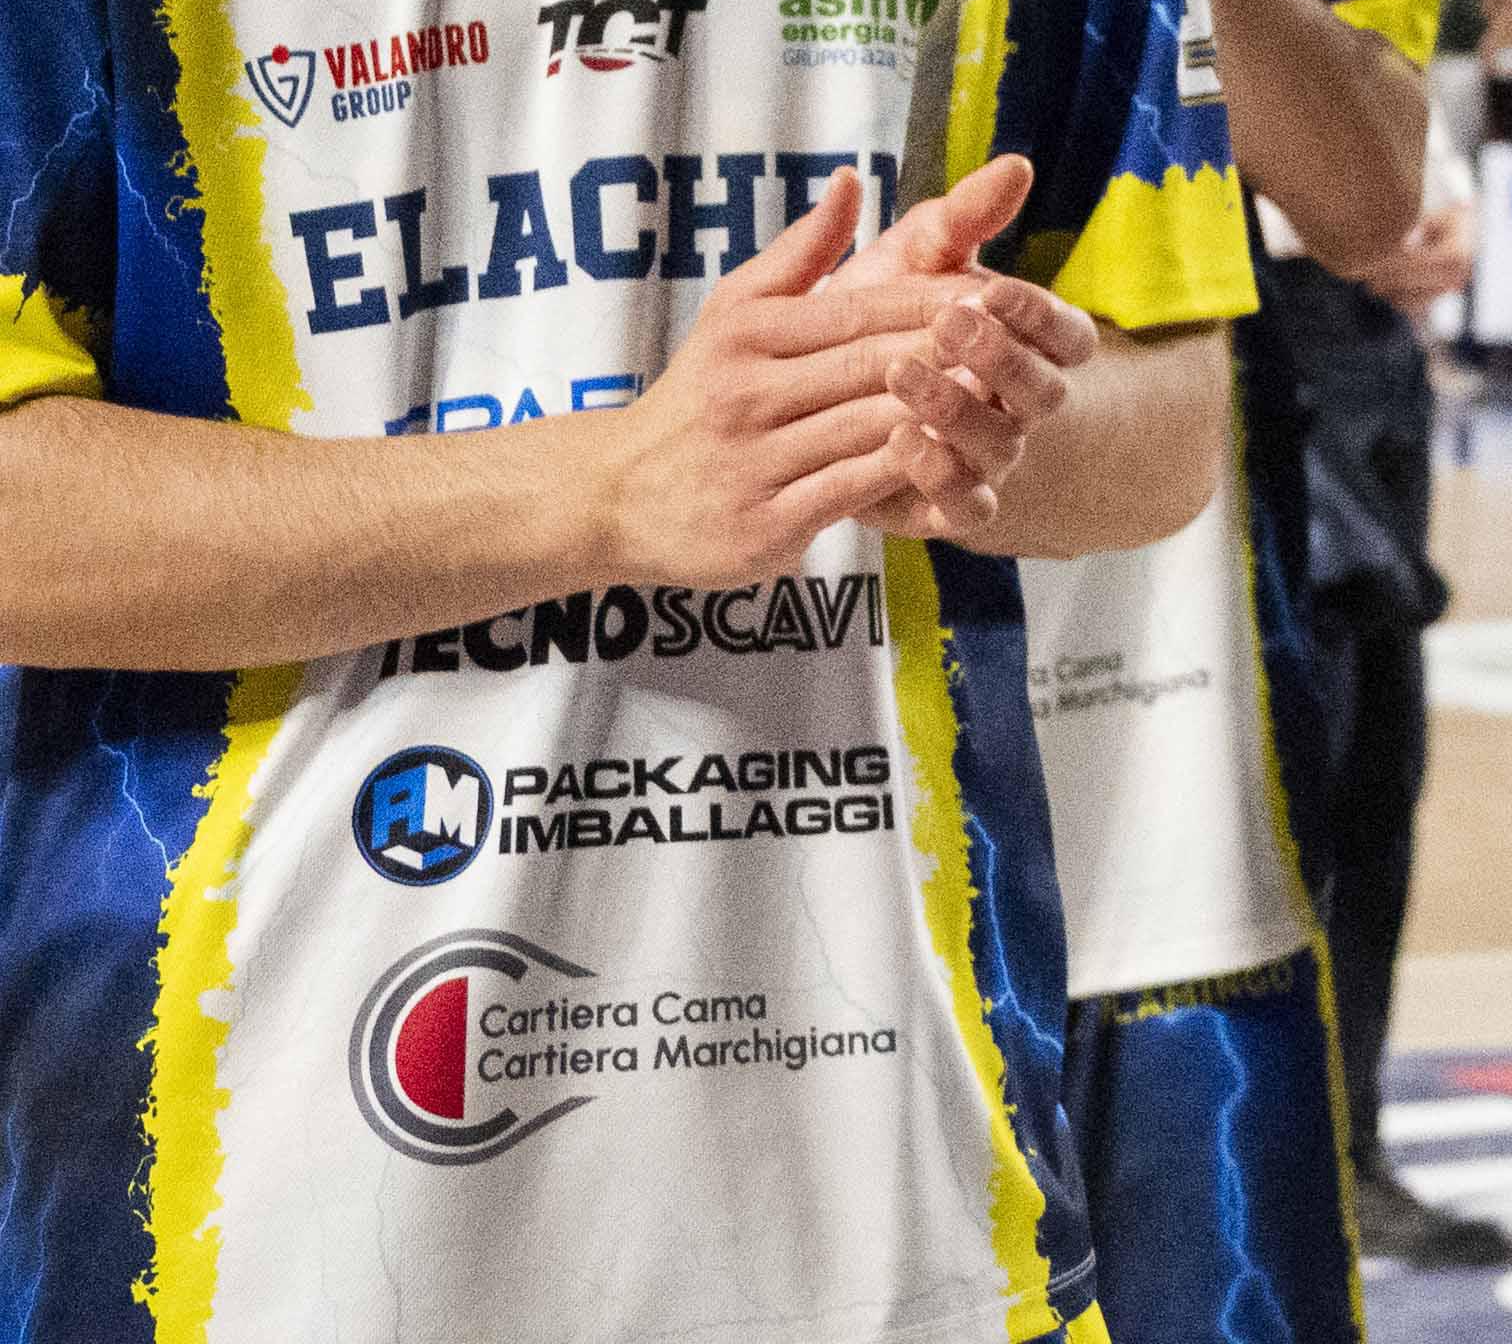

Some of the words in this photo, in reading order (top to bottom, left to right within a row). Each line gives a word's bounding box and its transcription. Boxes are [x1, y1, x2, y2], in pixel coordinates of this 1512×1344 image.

[323, 19, 490, 90] VALANDRO
[782, 23, 897, 45] energia
[331, 80, 413, 123] GROUP
[504, 745, 890, 806] PACKAGING
[498, 793, 895, 855] IMBALLAGGI
[478, 996, 638, 1039] Cartiera
[652, 991, 768, 1024] Cama
[477, 1040, 639, 1084] Cartiera
[653, 1026, 898, 1072] Marchigiana
